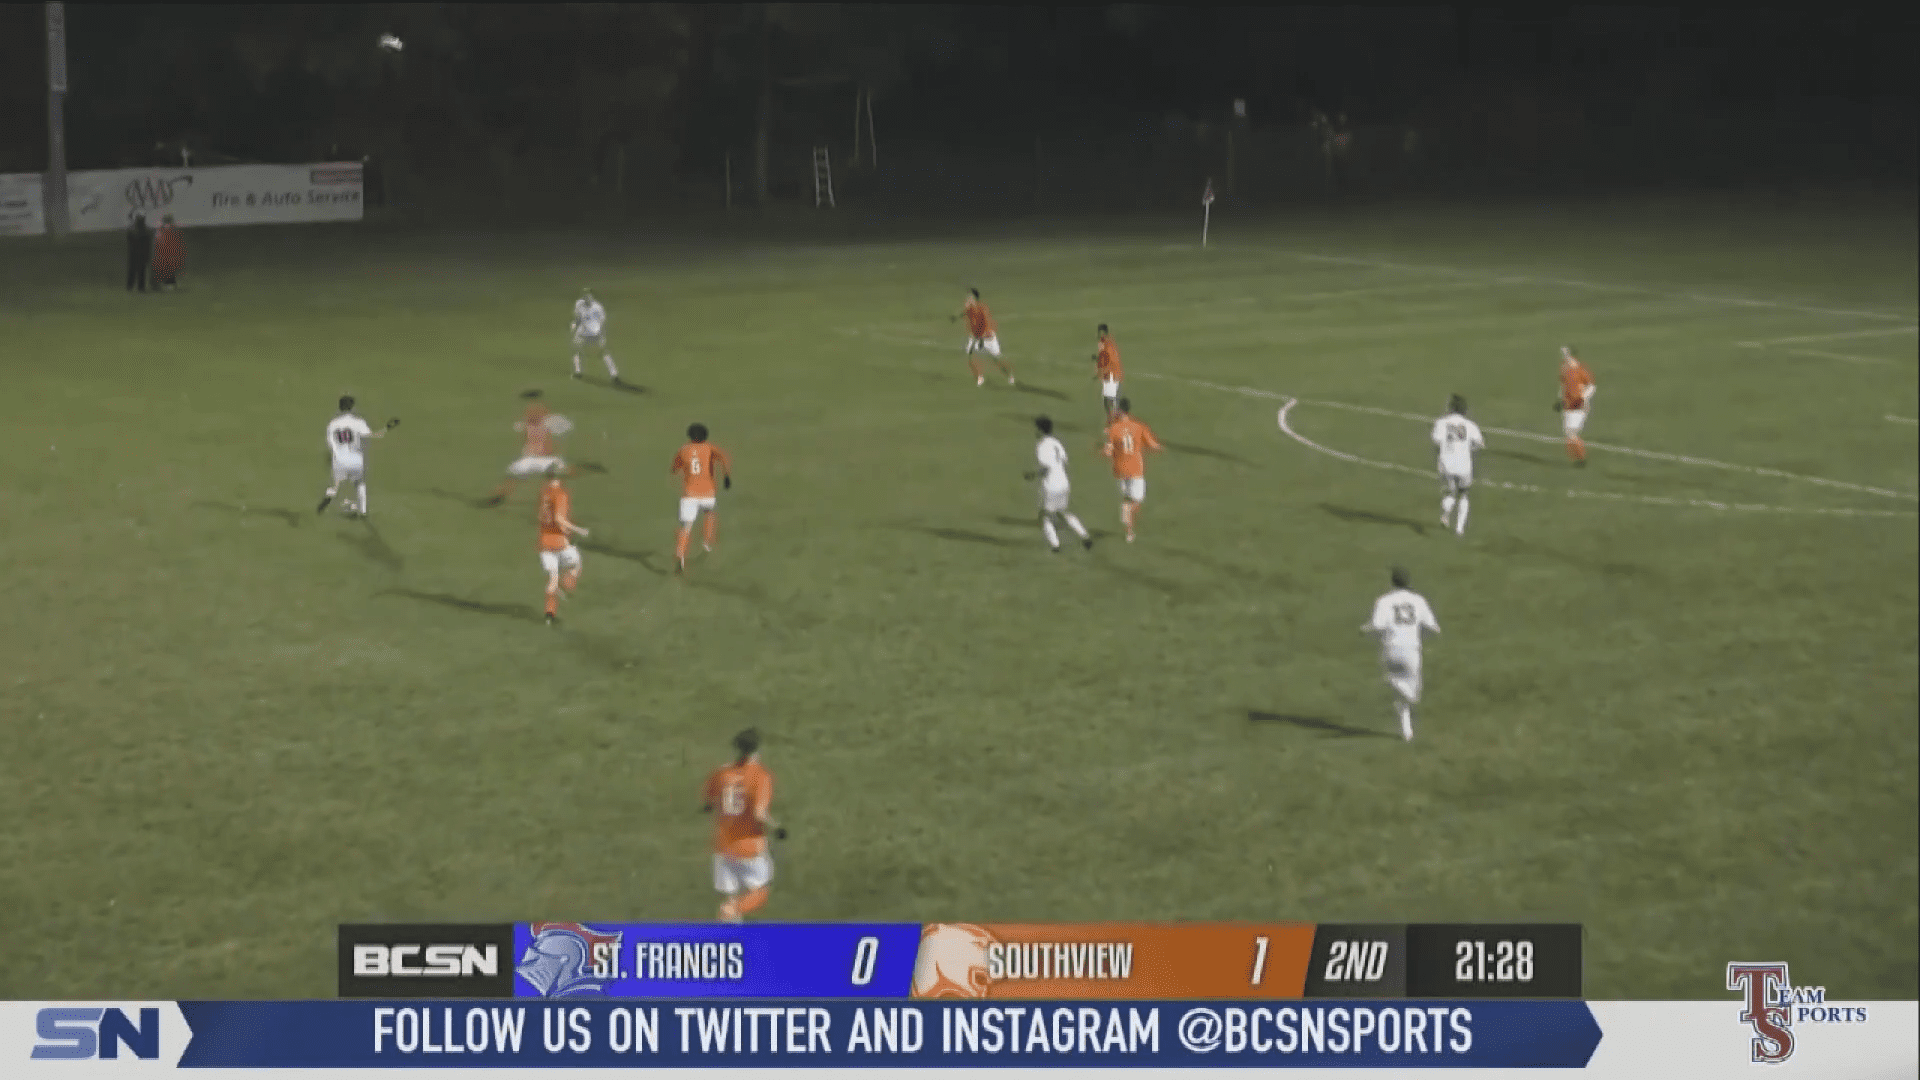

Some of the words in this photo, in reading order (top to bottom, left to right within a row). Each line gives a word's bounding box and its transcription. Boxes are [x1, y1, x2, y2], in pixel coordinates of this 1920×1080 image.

[262, 191, 301, 206] Auto
[308, 189, 361, 204] Service
[1393, 604, 1416, 625] 13
